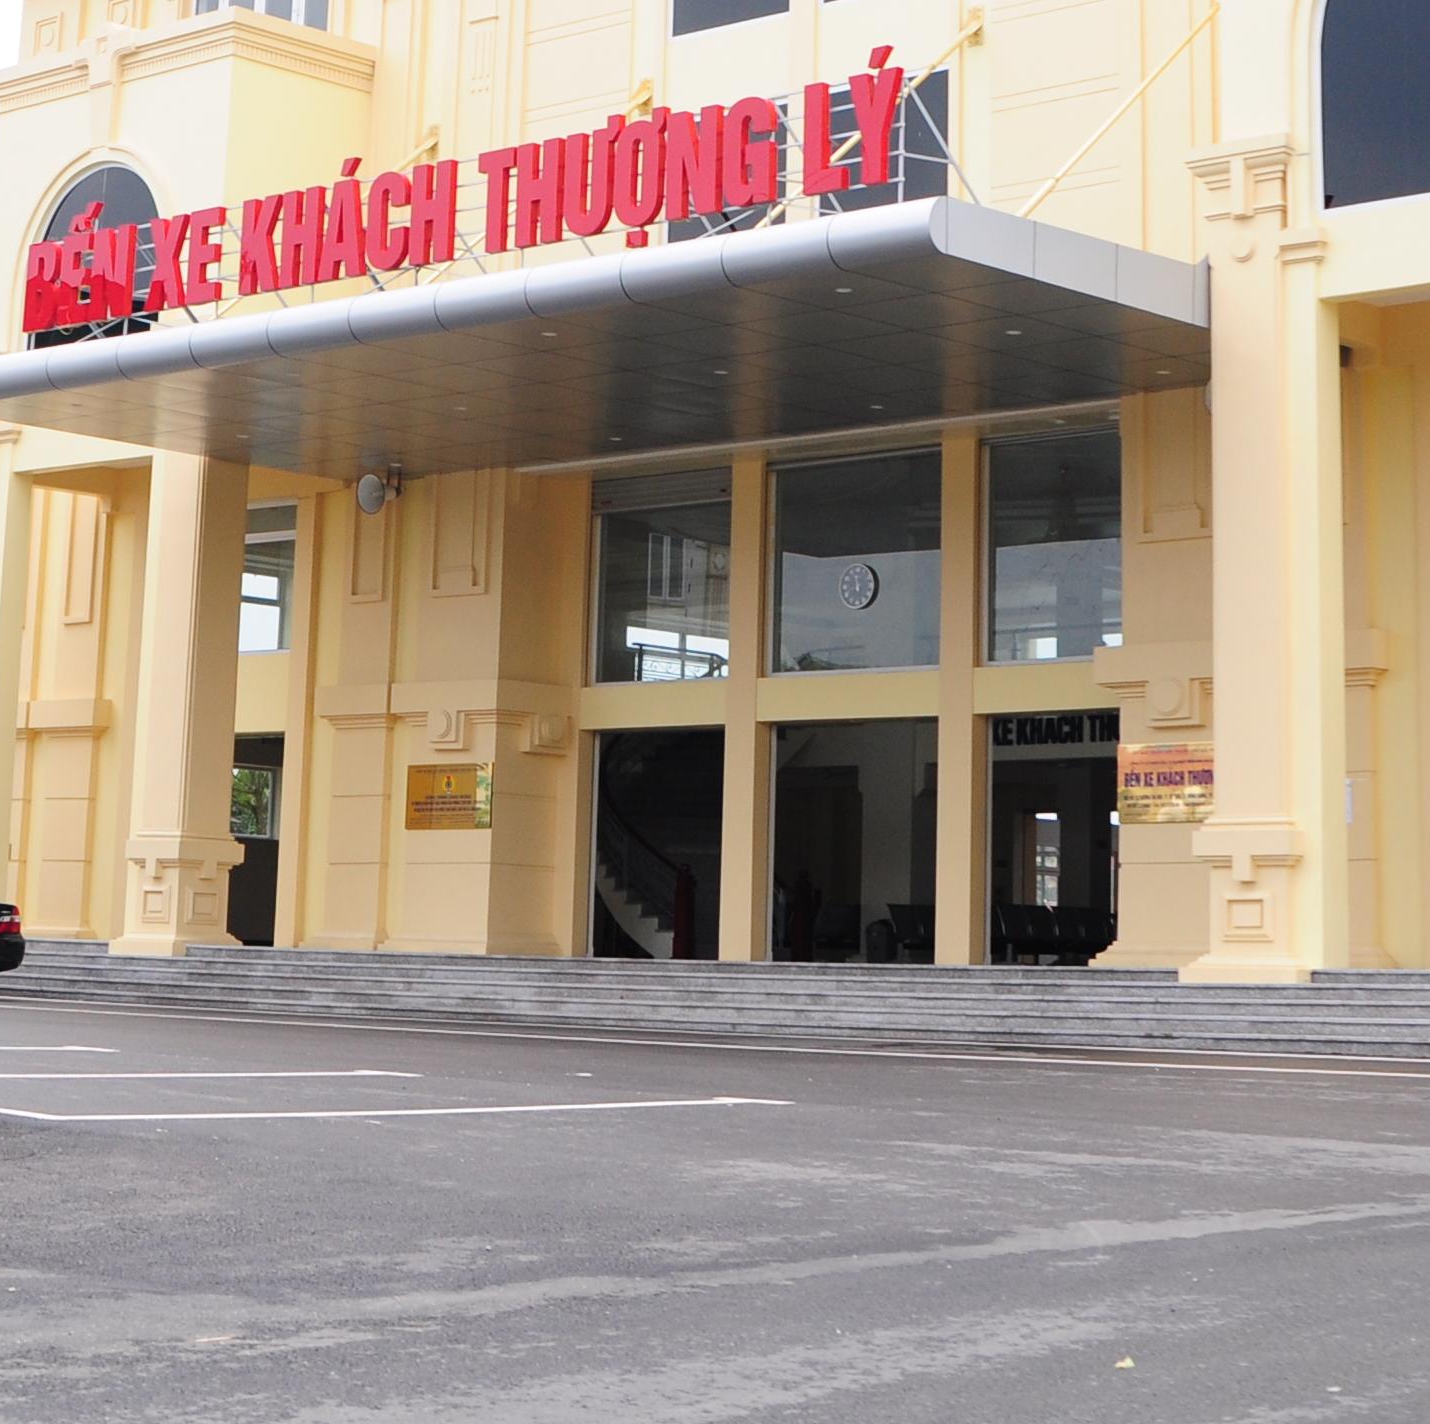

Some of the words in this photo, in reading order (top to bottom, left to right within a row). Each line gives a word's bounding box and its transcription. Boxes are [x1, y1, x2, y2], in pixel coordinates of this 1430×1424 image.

[23, 201, 137, 332] BẾN
[144, 206, 227, 312] XE
[238, 157, 459, 296] KHÁCH
[479, 96, 777, 248] THƯỢNG
[803, 45, 904, 196] LÝ
